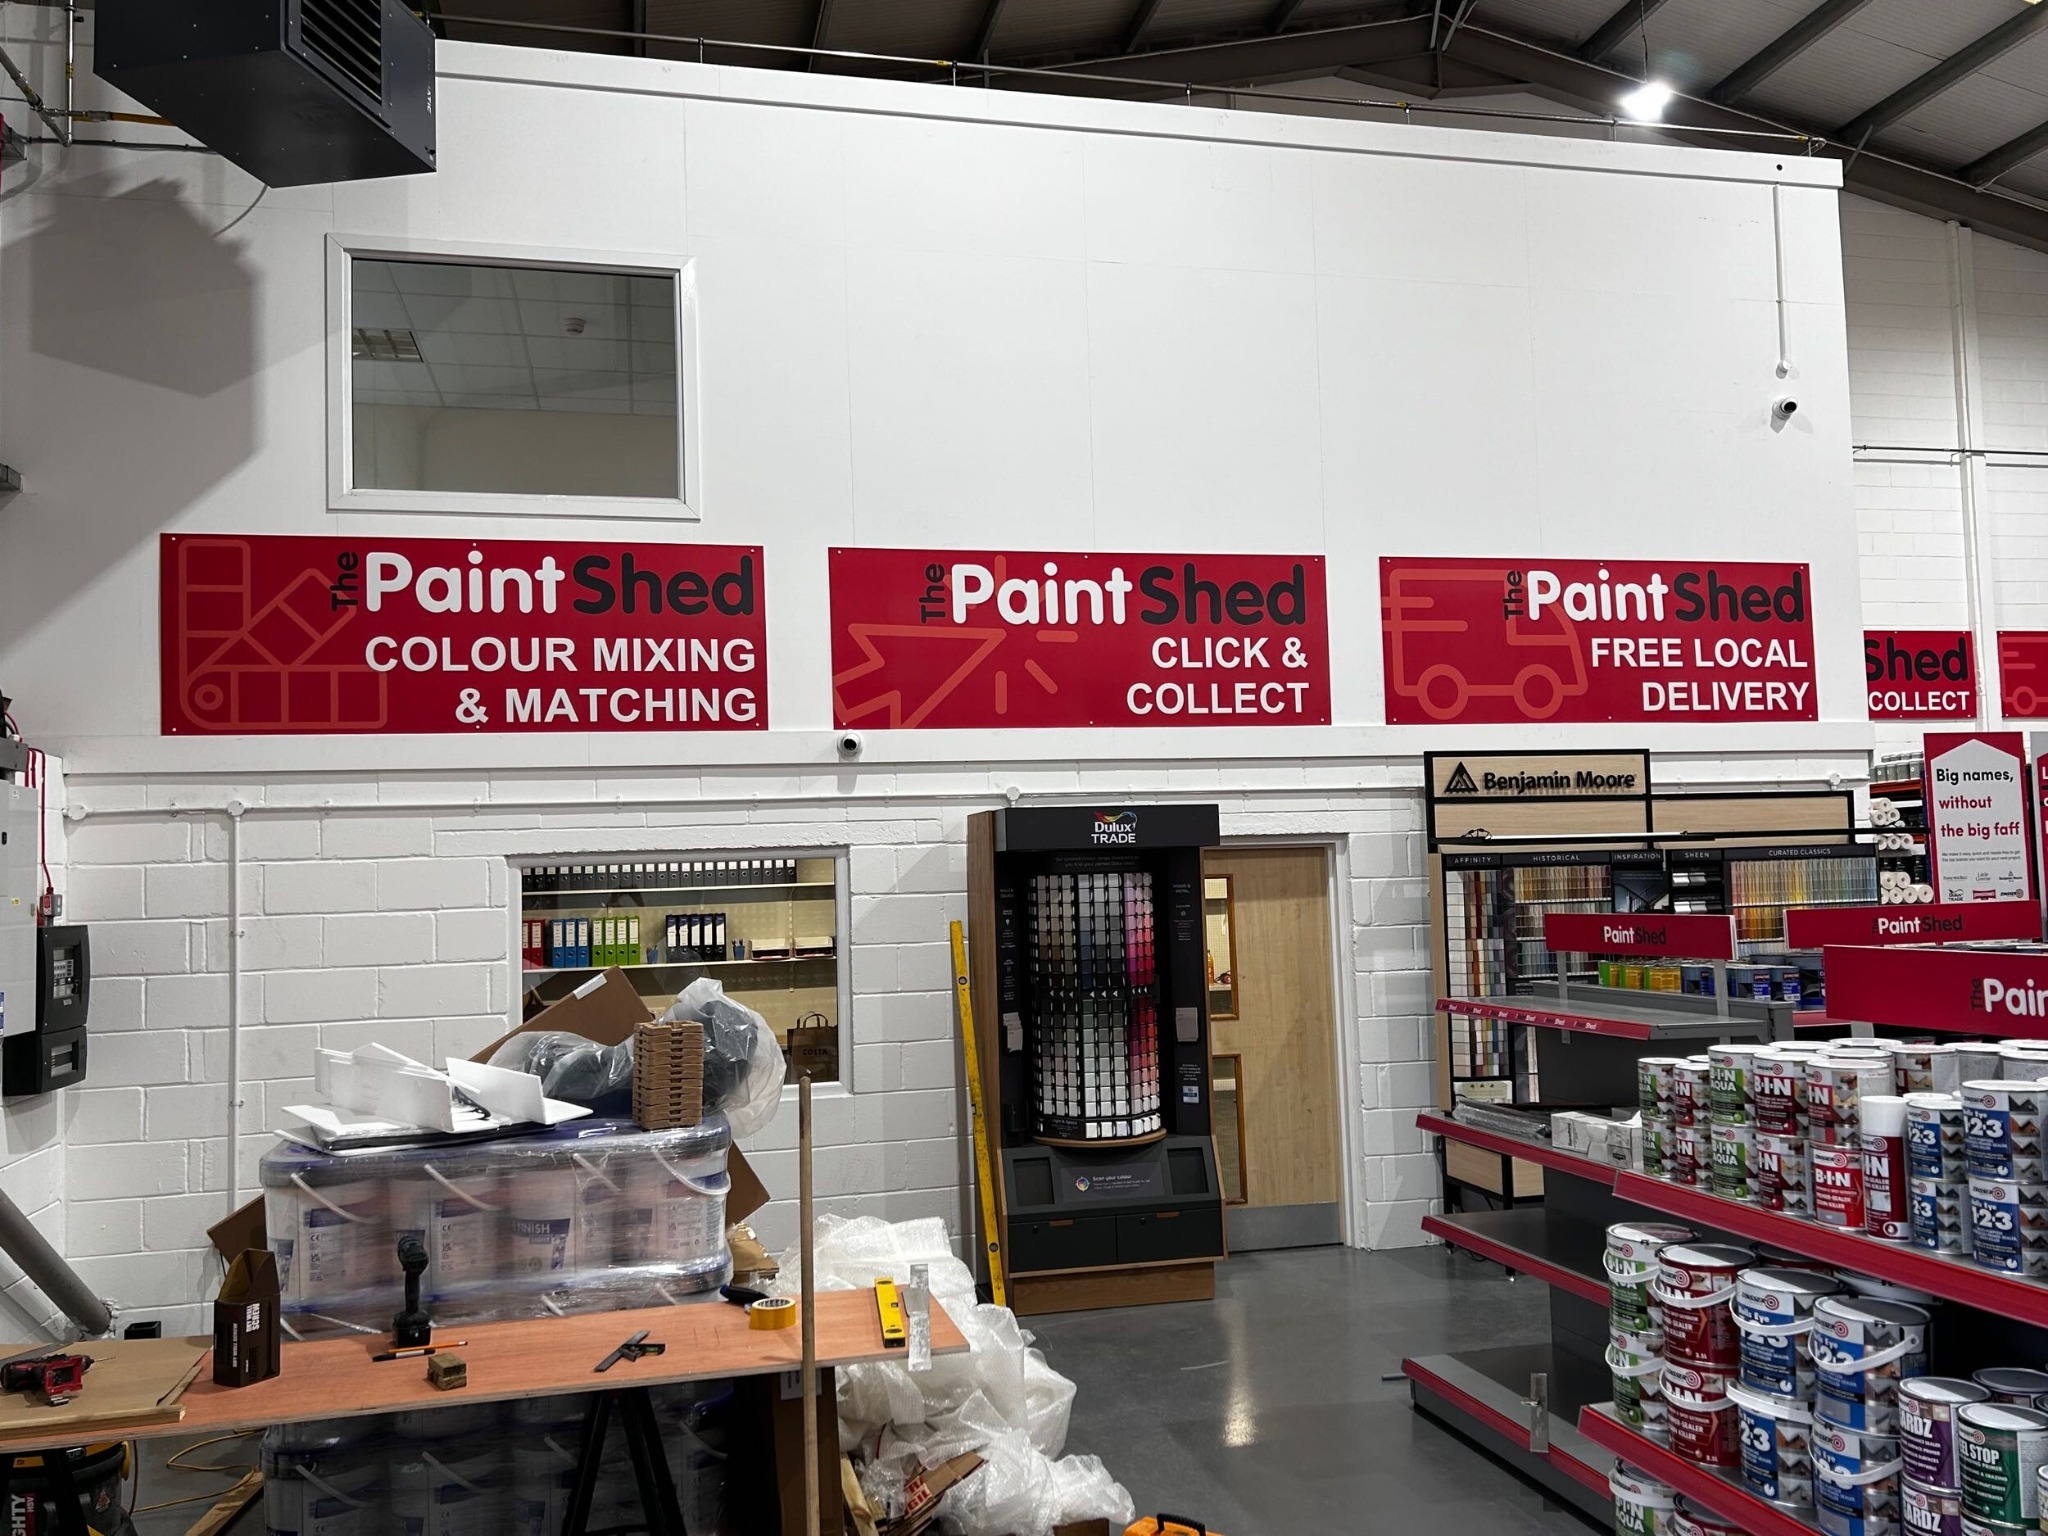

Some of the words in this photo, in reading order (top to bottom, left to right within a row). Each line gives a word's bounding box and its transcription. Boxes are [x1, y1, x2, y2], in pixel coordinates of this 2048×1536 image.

[330, 551, 359, 612] The
[918, 563, 946, 623] The
[1503, 570, 1523, 620] The
[365, 636, 576, 673] COLOUR
[593, 638, 756, 674] MIXING
[1152, 637, 1269, 669] CLICK
[1282, 637, 1309, 669] &
[1592, 637, 1684, 668] FREE
[1695, 638, 1808, 668] LOCAL
[455, 687, 488, 723] &
[505, 687, 757, 724] MATCHING
[1126, 682, 1309, 715] COLLECT
[1642, 682, 1809, 712] DELIVERY
[1868, 690, 1970, 711] COLLECT
[1484, 771, 1571, 794] Benjamin
[1576, 771, 1635, 788] Moore
[1936, 768, 1959, 785] Big
[1963, 770, 2014, 783] names,
[1938, 795, 1992, 809] without
[1090, 833, 1136, 844] TRADE
[1094, 821, 1132, 833] Dulux
[1940, 823, 1963, 837] the
[1968, 823, 1990, 839] big
[1994, 822, 2020, 835] faff
[1800, 848, 1831, 856] CLASSICS
[1971, 978, 1982, 1010] The
[802, 1048, 828, 1056] COSTA
[252, 1303, 260, 1331] SCREW
[1969, 1443, 2000, 1465] STOP
[25, 1496, 35, 1513] HSV
